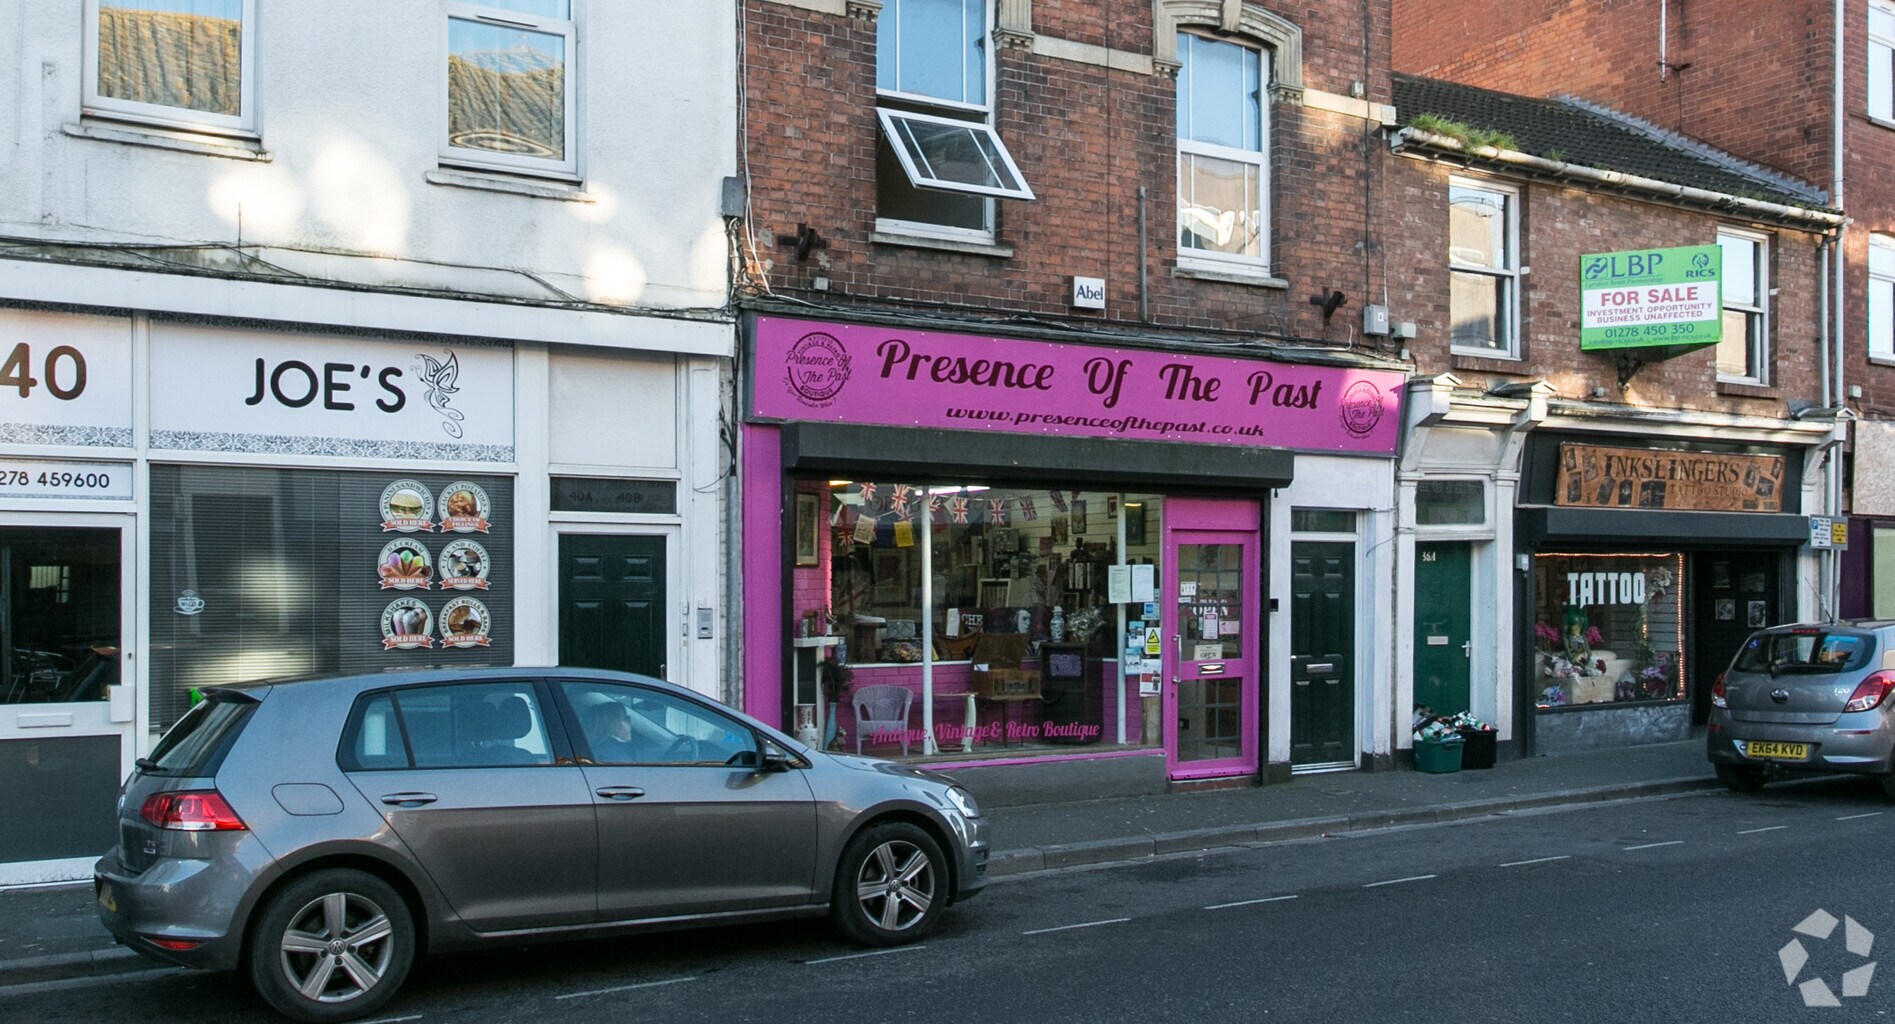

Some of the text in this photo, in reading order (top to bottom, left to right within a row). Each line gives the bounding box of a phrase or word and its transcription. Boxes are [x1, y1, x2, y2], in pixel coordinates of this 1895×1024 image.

[1611, 254, 1663, 278] LBP
[1686, 269, 1716, 278] RICS
[1076, 285, 1104, 301] Abel
[1601, 287, 1699, 307] FOR SALE
[1587, 303, 1713, 316] INVESTMENT OPPORTUNITY
[1597, 310, 1703, 324] BUSINESS UNAFFECTED
[1605, 323, 1695, 338] 01278 450 350
[785, 350, 834, 366] Presence
[0, 342, 87, 401] 40
[802, 367, 853, 385] The Past
[876, 339, 1322, 410] Presence Of The Past
[245, 358, 406, 413] JOE'S
[800, 385, 833, 397] BOUTIQUE
[946, 408, 1264, 437] www.presenceofthepast.co.uk
[1603, 455, 1741, 484] INKSLINGERS
[37, 472, 110, 488] 459600
[383, 487, 395, 510] PANINI
[441, 485, 459, 506] JACKET
[569, 490, 642, 504] 40A 40B
[1670, 484, 1749, 498] TATTOO STUDIO
[387, 541, 424, 554] ICE CREAM
[452, 542, 466, 550] AND
[1567, 572, 1645, 609] TATTOO
[384, 599, 418, 635] MILKSHAKES
[441, 601, 460, 634] BREAKFAST
[461, 600, 481, 611] ROLLS
[962, 613, 984, 626] CHE
[935, 723, 989, 742] Vintage
[990, 722, 1001, 738] &
[1005, 721, 1040, 738] Retro
[1043, 720, 1100, 742] Boutique
[1752, 743, 1803, 756] EK64 KVD
